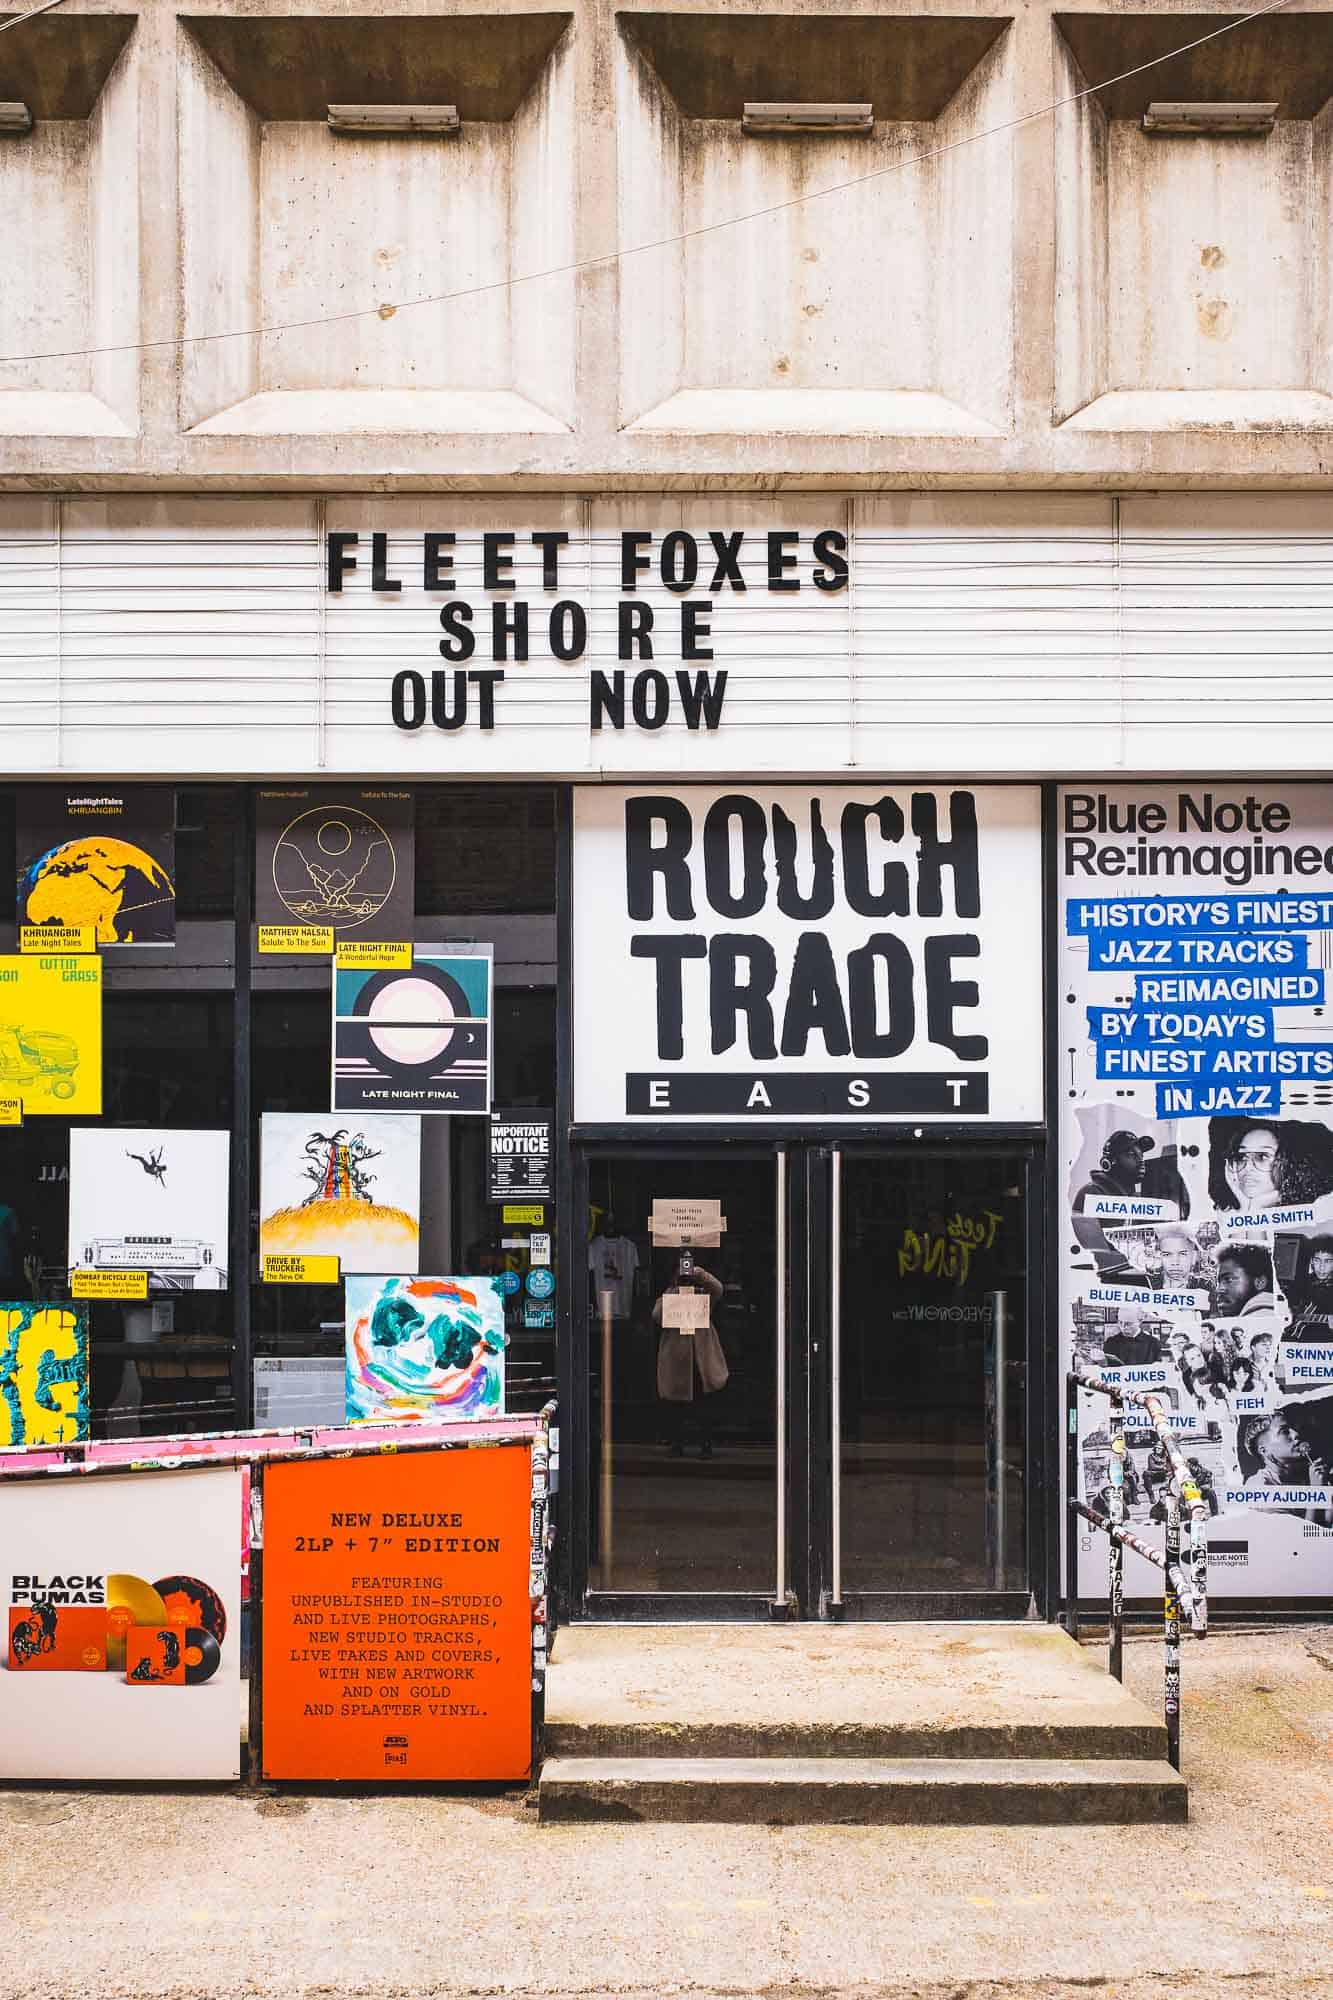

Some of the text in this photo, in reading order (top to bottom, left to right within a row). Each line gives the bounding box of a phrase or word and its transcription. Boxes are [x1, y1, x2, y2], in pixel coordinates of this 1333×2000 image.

[327, 531, 849, 592] FLEET FOXES
[439, 600, 714, 661] SHORE
[391, 669, 728, 730] OUT NOW
[1064, 793, 1291, 833] Blue Note
[625, 791, 981, 921] ROUGH
[1080, 900, 1333, 928] HISTORY’S FINEST
[23, 928, 81, 937] KHRUANGBIN
[261, 928, 299, 936] MATTHEW
[23, 939, 82, 949] Late Night Tales
[339, 944, 357, 952] LATE
[359, 944, 382, 952] NIGHT
[1099, 940, 1294, 964] JAZZ TRACKS
[630, 932, 989, 1061] TRADE
[1141, 976, 1319, 1003] REIMAGINED
[1101, 1013, 1266, 1038] BY TODAY’S
[1104, 1049, 1333, 1074] FINEST ARTISTS
[362, 1090, 460, 1099] LATE NIGHT FINAL
[649, 1080, 968, 1107] EAST
[1163, 1086, 1273, 1112] IN JAZZ
[491, 1127, 549, 1137] IMPORTANT
[491, 1137, 549, 1153] NOTICE
[1095, 1202, 1163, 1216] ALFA MIST
[1226, 1210, 1314, 1228] JORJA SMITH
[266, 1264, 305, 1272] TRUCKERS
[1089, 1289, 1195, 1306] BLUE LAB BEATS
[1286, 1348, 1333, 1360] SKINNY
[1100, 1371, 1166, 1383] MR JUKES
[1236, 1398, 1265, 1409] FIEH
[1226, 1491, 1327, 1503] POPPY AJUDHA
[331, 1513, 463, 1527] NEW DELUXE
[295, 1537, 334, 1552] 2LP
[345, 1539, 357, 1550] +
[405, 1538, 500, 1552] EDITION
[12, 1575, 104, 1589] BLACK
[351, 1577, 443, 1589] FEATURING
[12, 1591, 105, 1603] PUMAS
[291, 1595, 503, 1607] UNPUBLISHED IN-STUDIO
[293, 1613, 498, 1628] AND LIVE PHOTOGRAPHS,
[309, 1632, 482, 1645] NEW STUDIO TRACKS,
[290, 1650, 501, 1664] LIVE TAKES AND COVERS,
[318, 1668, 475, 1680] WITH NEW ARTWORK
[342, 1686, 451, 1697] AND ON GOLD
[303, 1704, 488, 1716] AND SPLATTER VINYL.
